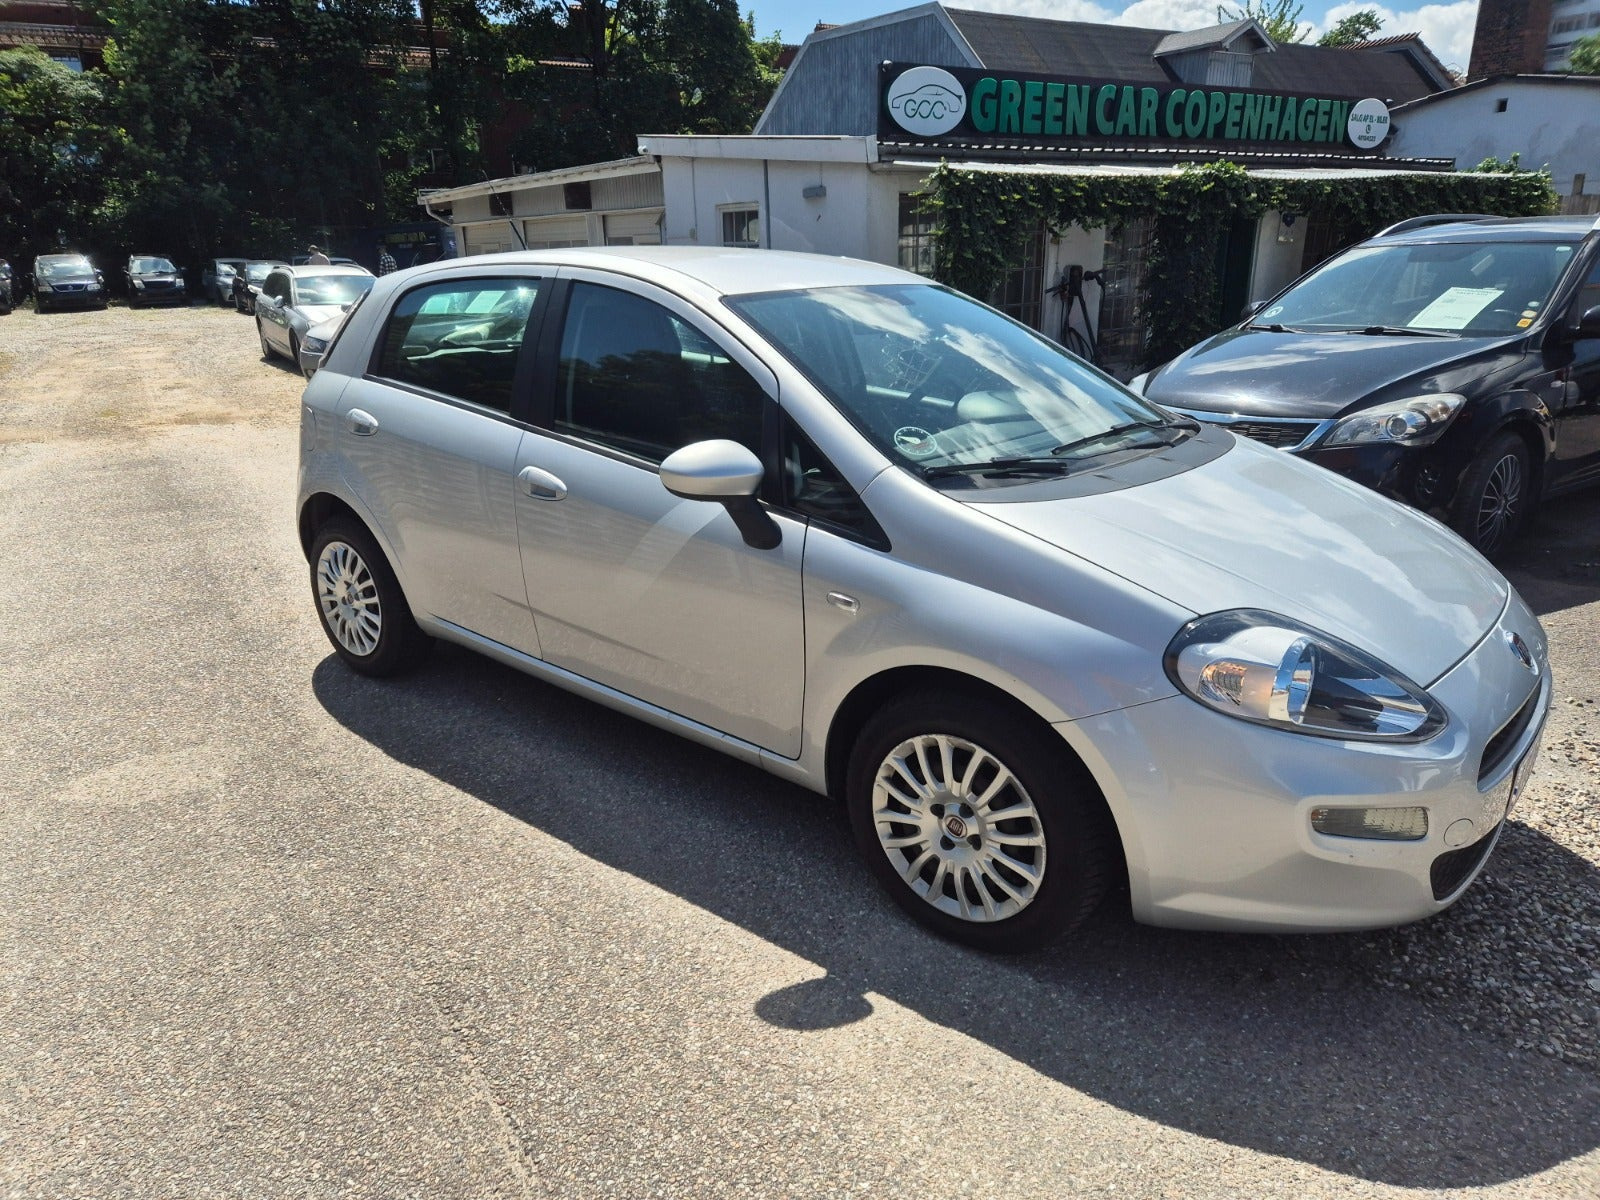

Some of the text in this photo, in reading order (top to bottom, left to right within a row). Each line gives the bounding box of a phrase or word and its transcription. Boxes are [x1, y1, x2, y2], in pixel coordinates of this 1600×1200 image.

[971, 77, 1348, 142] GREEN CAR COPENHAGEN
